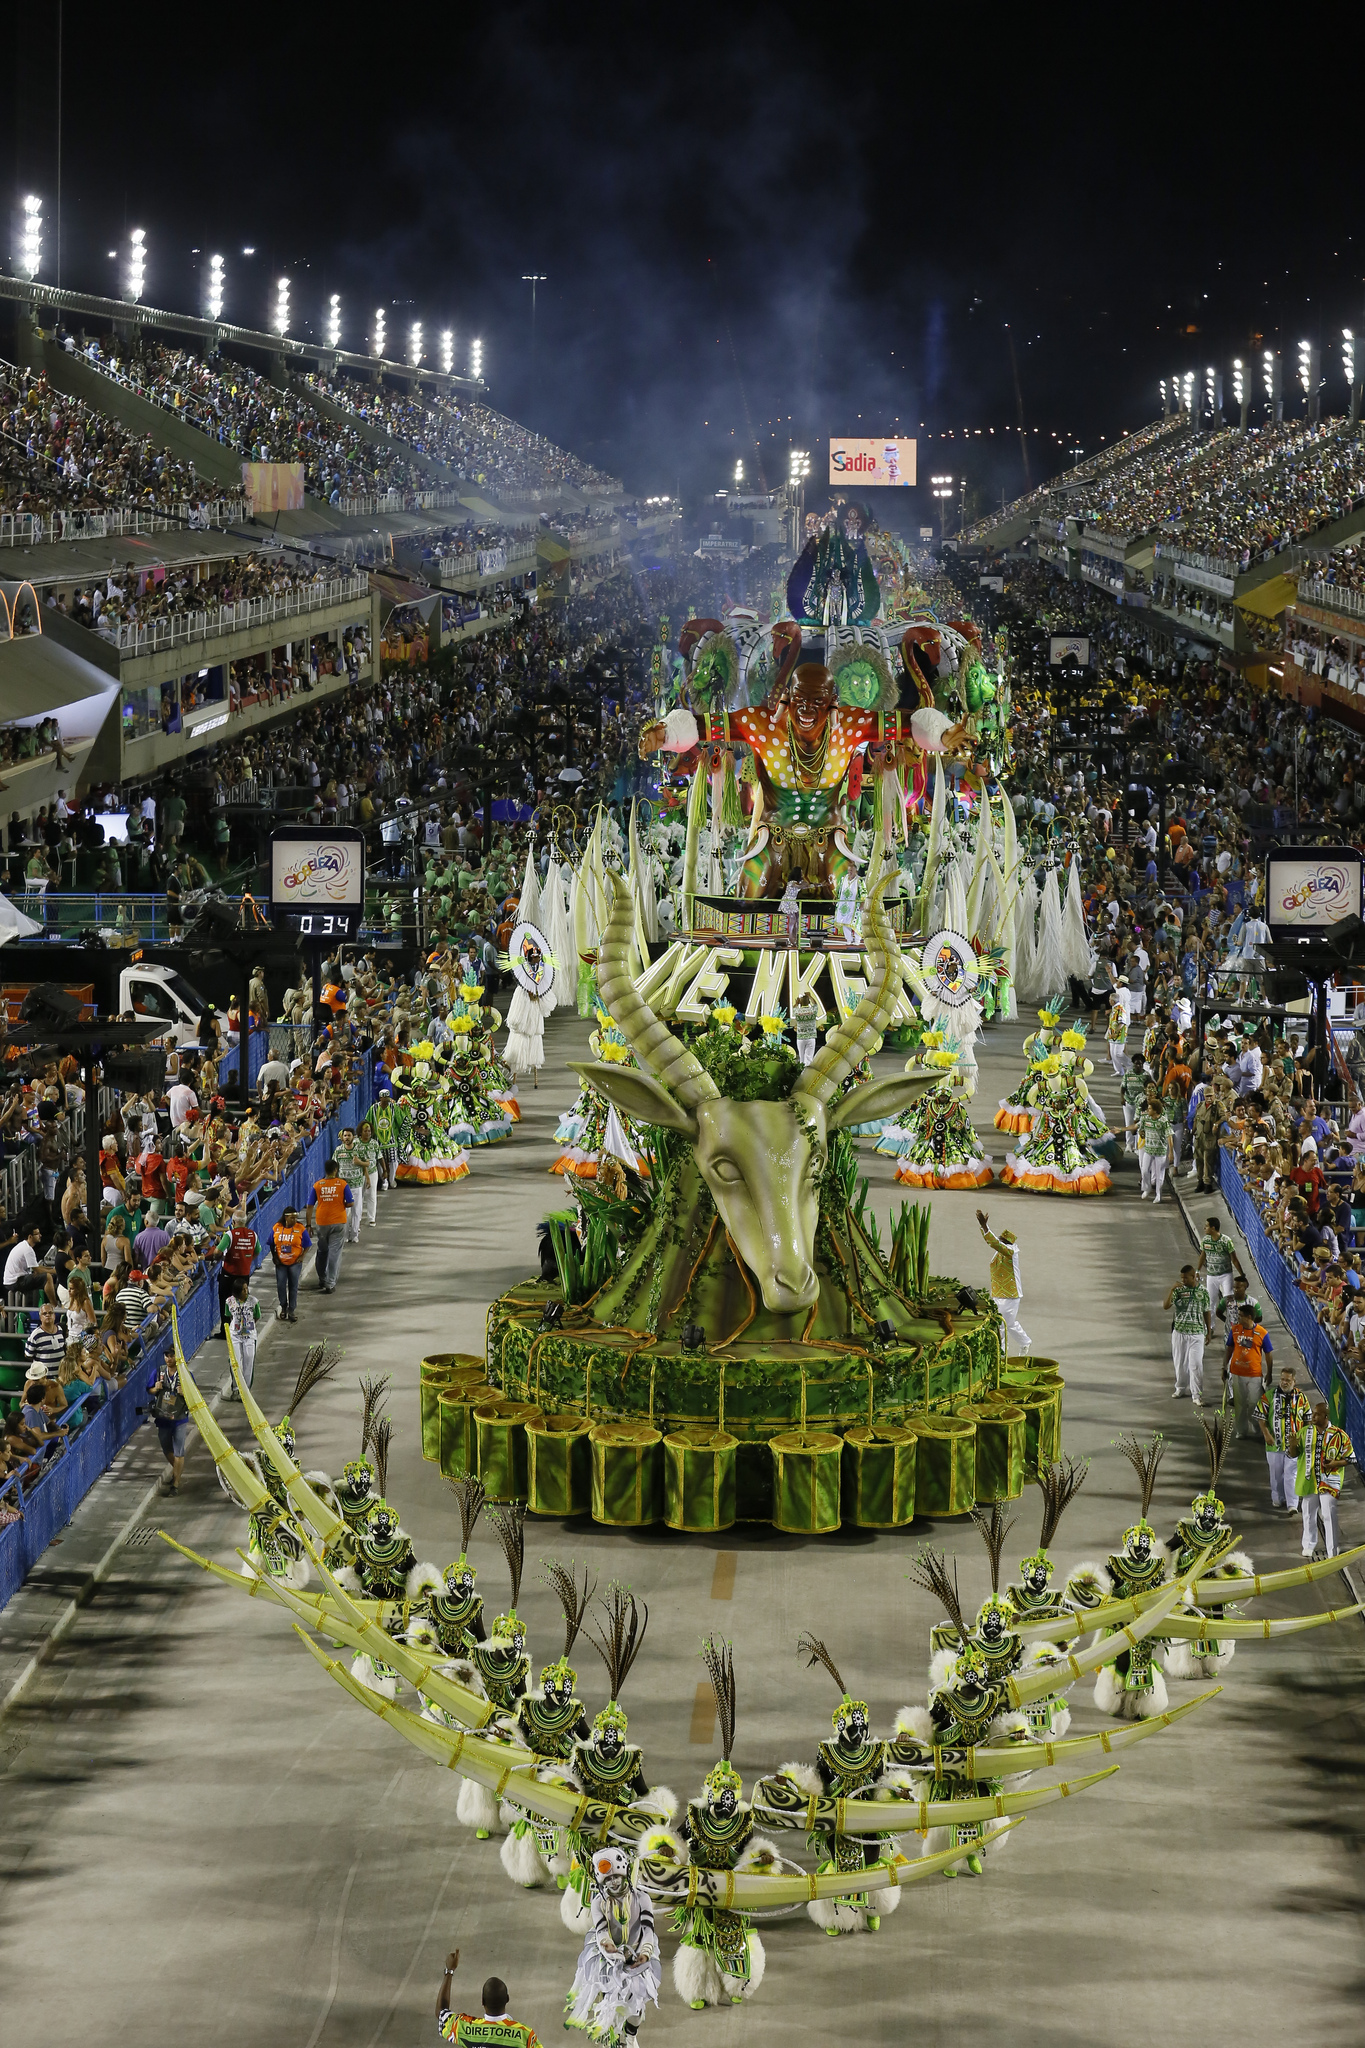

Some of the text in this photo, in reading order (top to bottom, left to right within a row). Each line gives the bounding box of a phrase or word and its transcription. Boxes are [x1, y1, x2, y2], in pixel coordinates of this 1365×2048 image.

[831, 451, 876, 472] Sadia
[702, 540, 739, 548] IMPERATRIZ
[284, 855, 339, 888] GLOBELEZA
[1283, 876, 1339, 910] GLOBELEZA
[321, 1186, 337, 1195] STAFF
[278, 1233, 294, 1242] STAFF
[465, 2026, 522, 2039] DIRETORIA
